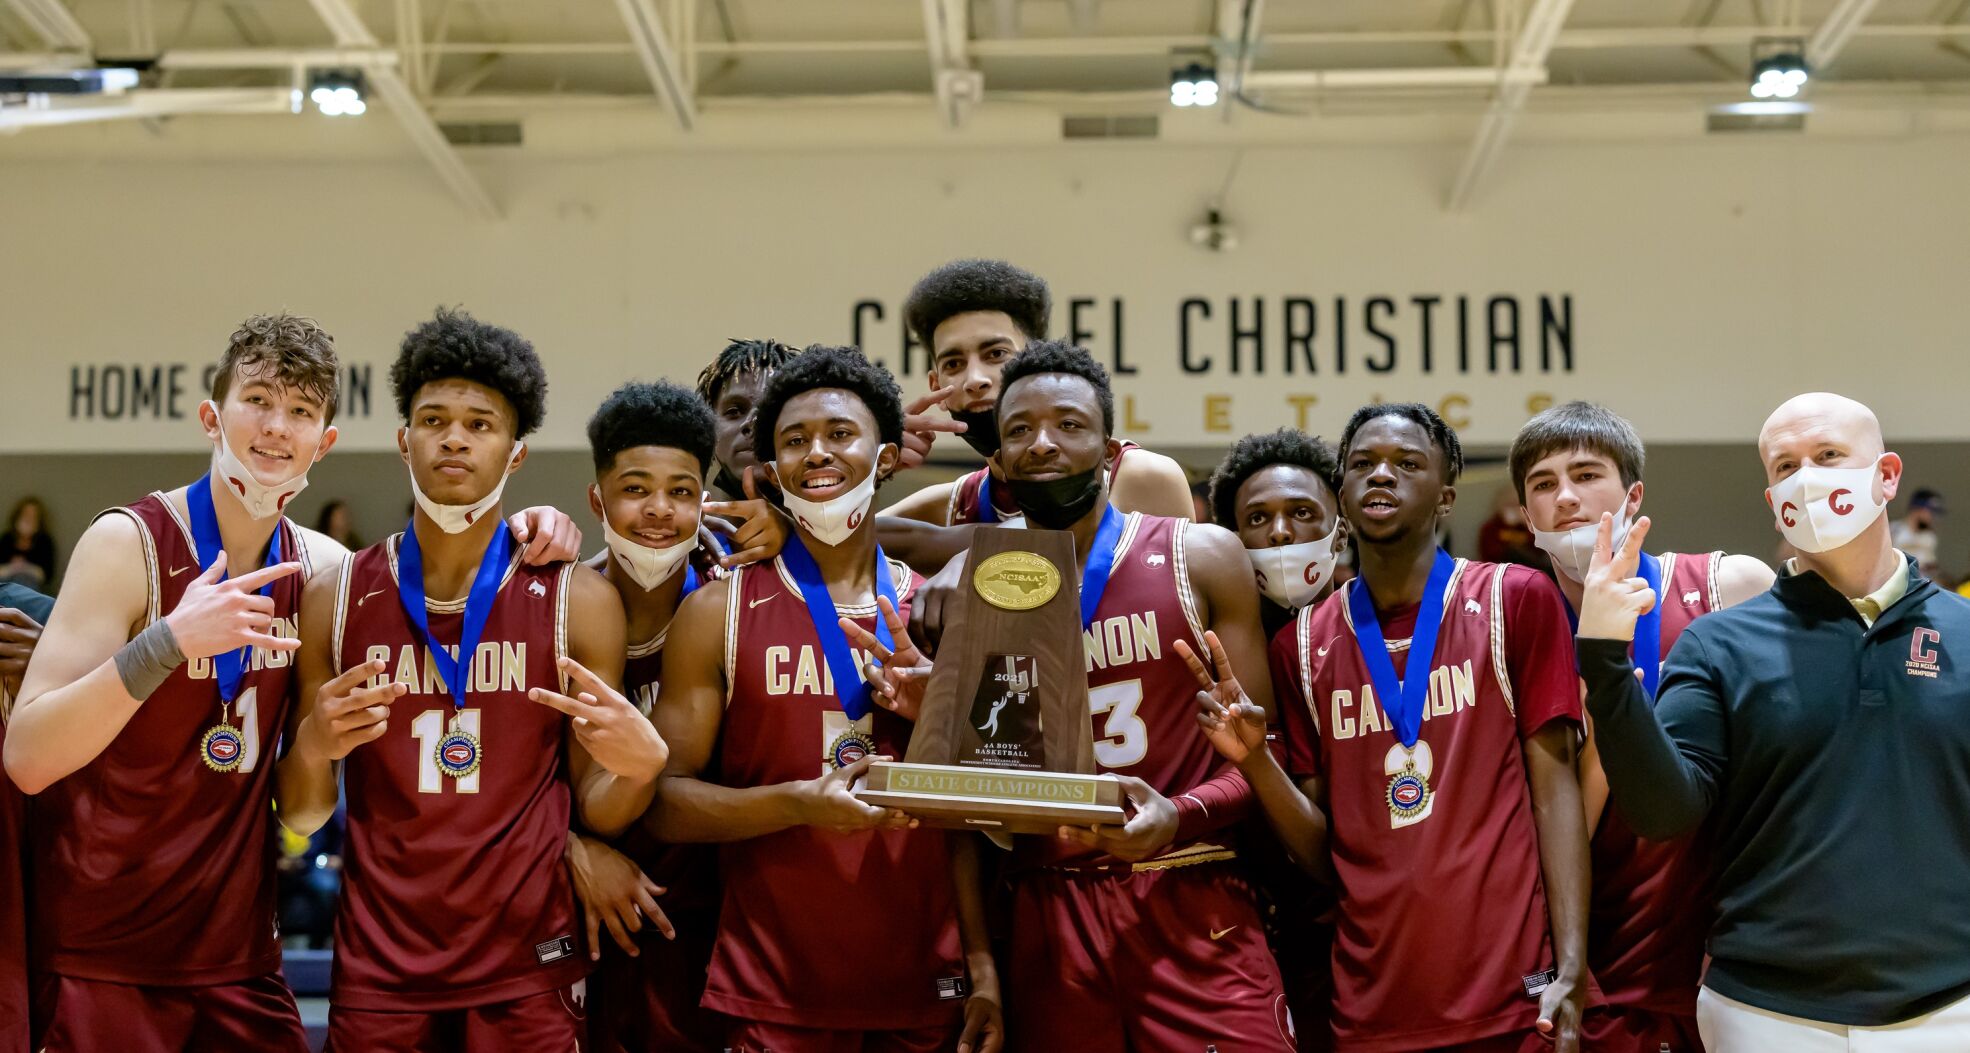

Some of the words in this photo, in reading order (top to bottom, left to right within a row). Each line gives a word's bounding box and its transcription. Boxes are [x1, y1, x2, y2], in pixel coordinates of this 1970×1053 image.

[852, 297, 1137, 376] CHEL
[1179, 295, 1575, 374] CHRISTIAN
[70, 364, 188, 420] HOME
[1000, 573, 1040, 582] NCISAA
[1911, 627, 1940, 664] C
[994, 673, 1023, 682] 2021
[1331, 658, 1476, 740] CAON
[975, 748, 1029, 757] BASKETBALL
[899, 773, 960, 791] STATE
[964, 778, 1085, 799] CHAMPIONS
